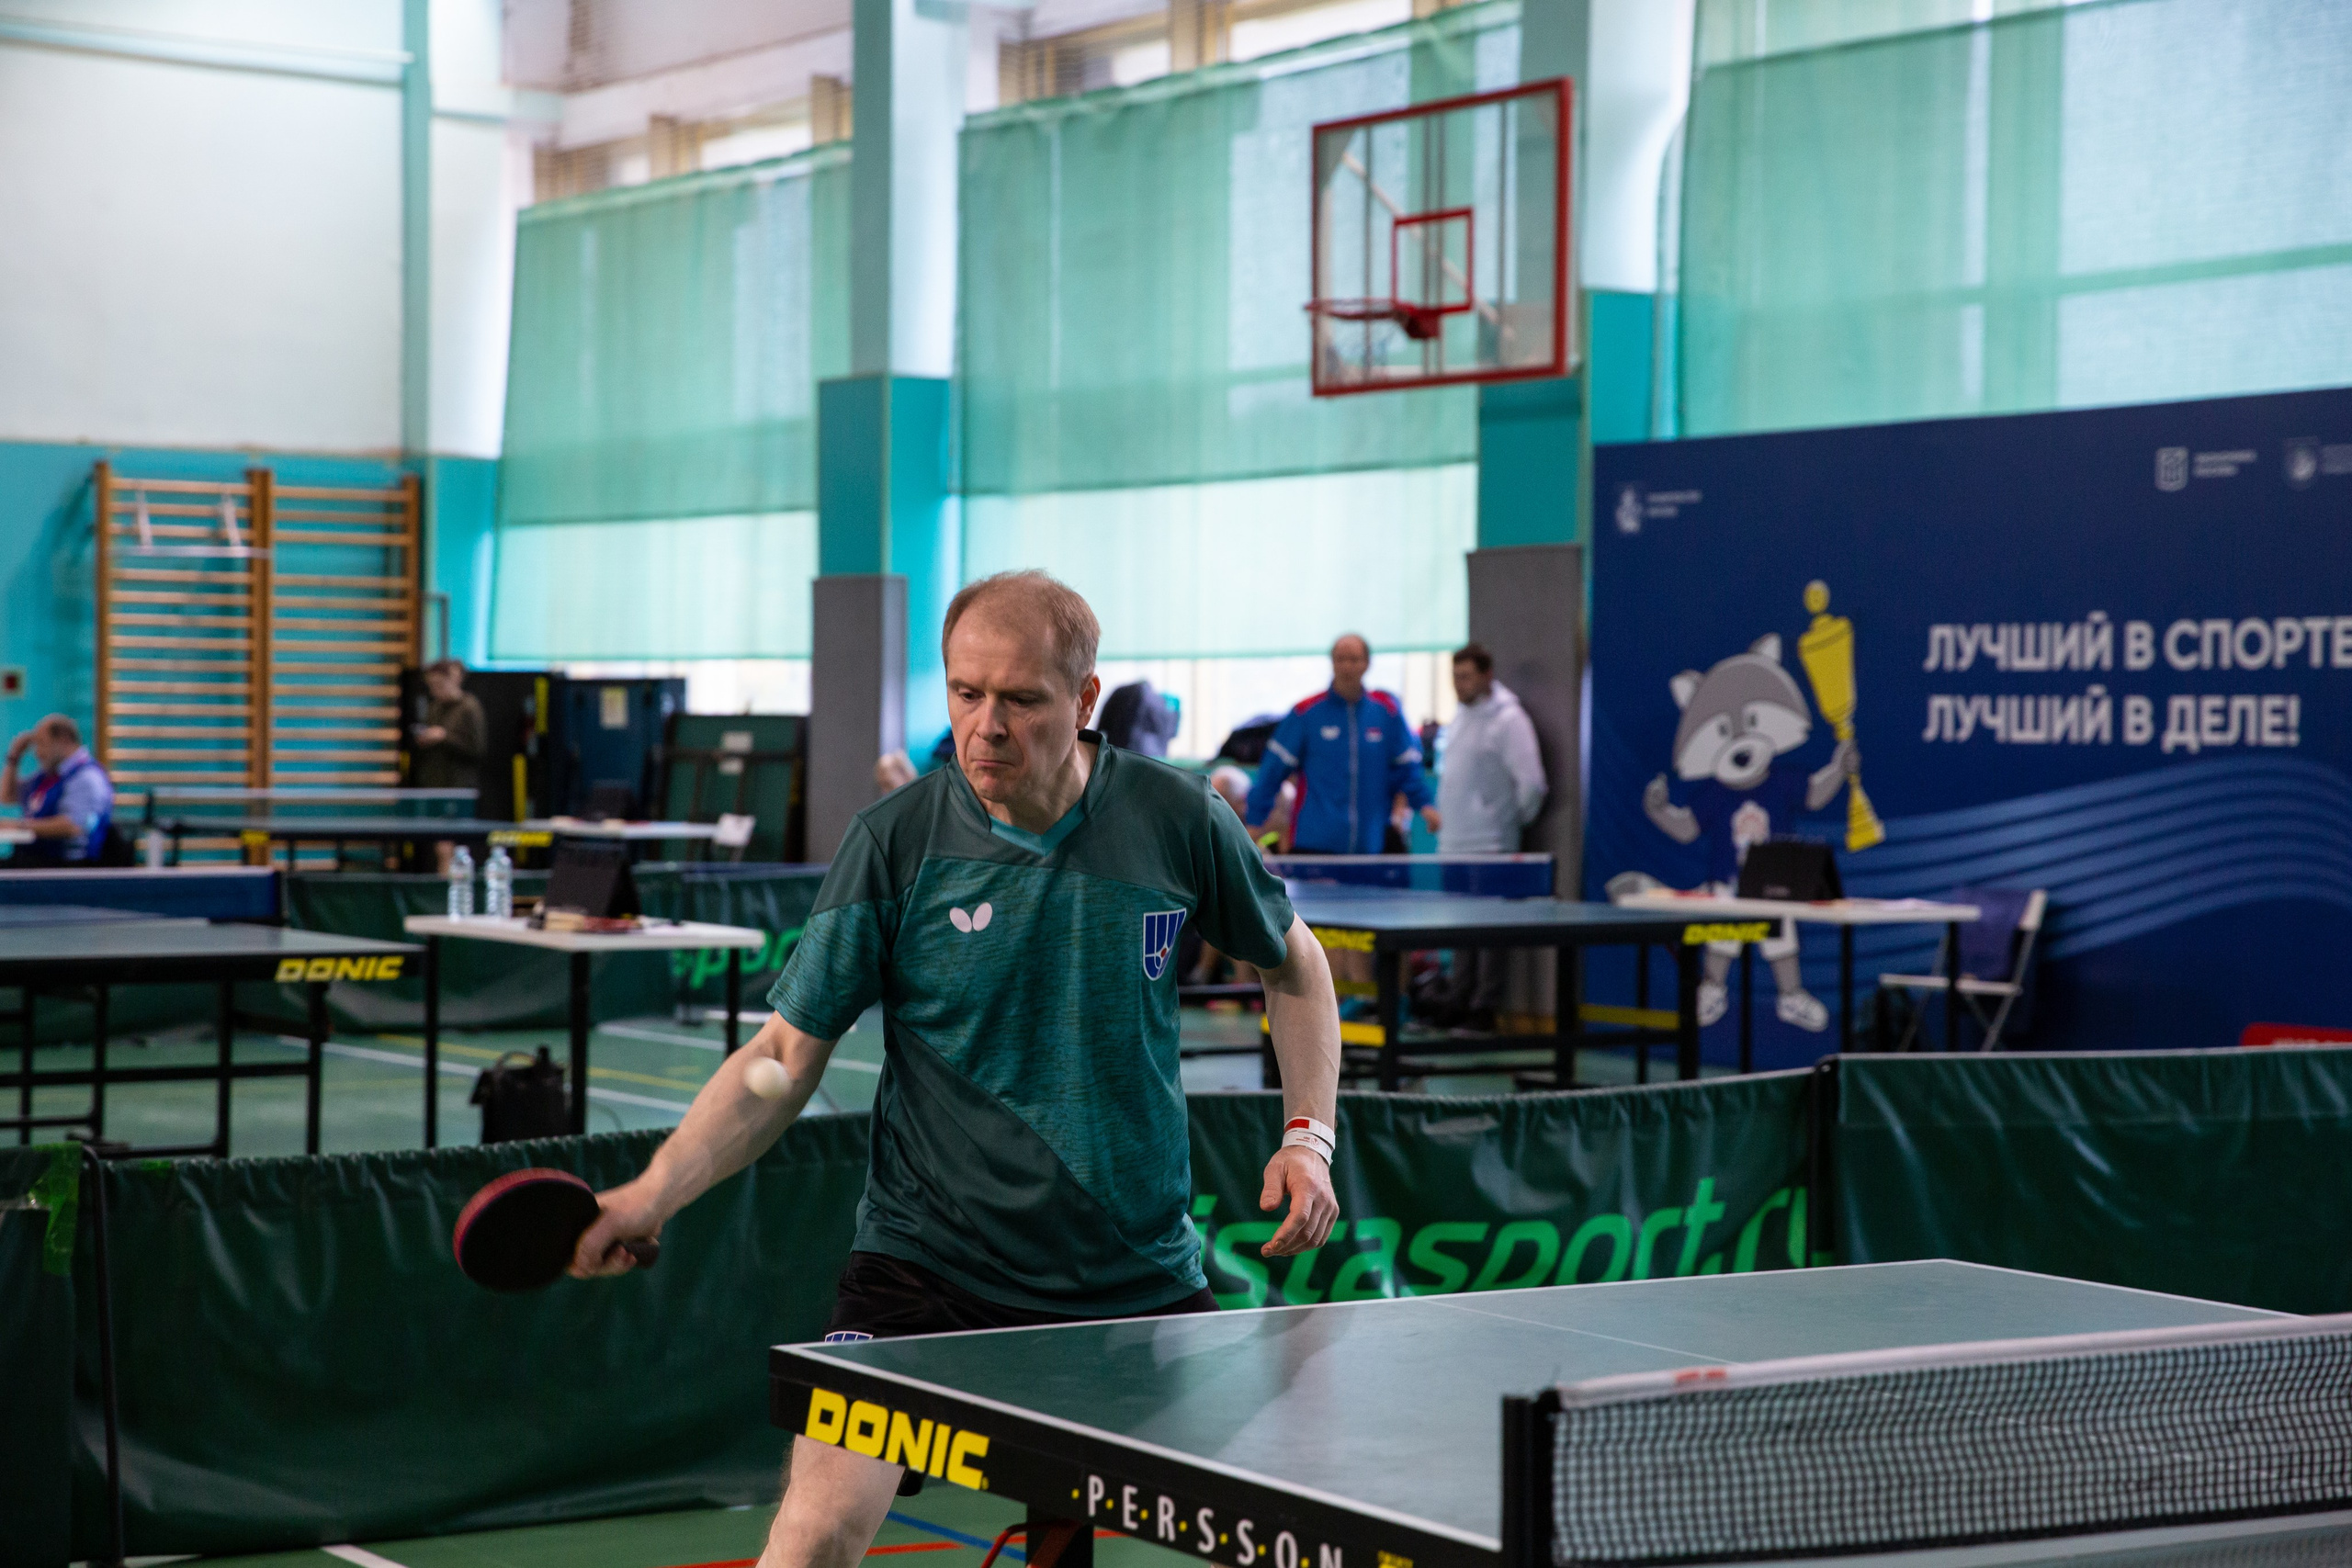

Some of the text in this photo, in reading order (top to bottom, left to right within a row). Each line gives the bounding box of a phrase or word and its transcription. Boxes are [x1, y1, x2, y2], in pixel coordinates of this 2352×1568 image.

[1923, 611, 2352, 671] ЛУЧШИЙ В СПОРТЕ
[1923, 684, 2301, 753] ЛУЧШИЙ В ДЕЛЕ!
[275, 956, 404, 983] DONIC
[806, 1387, 990, 1490] DONIC
